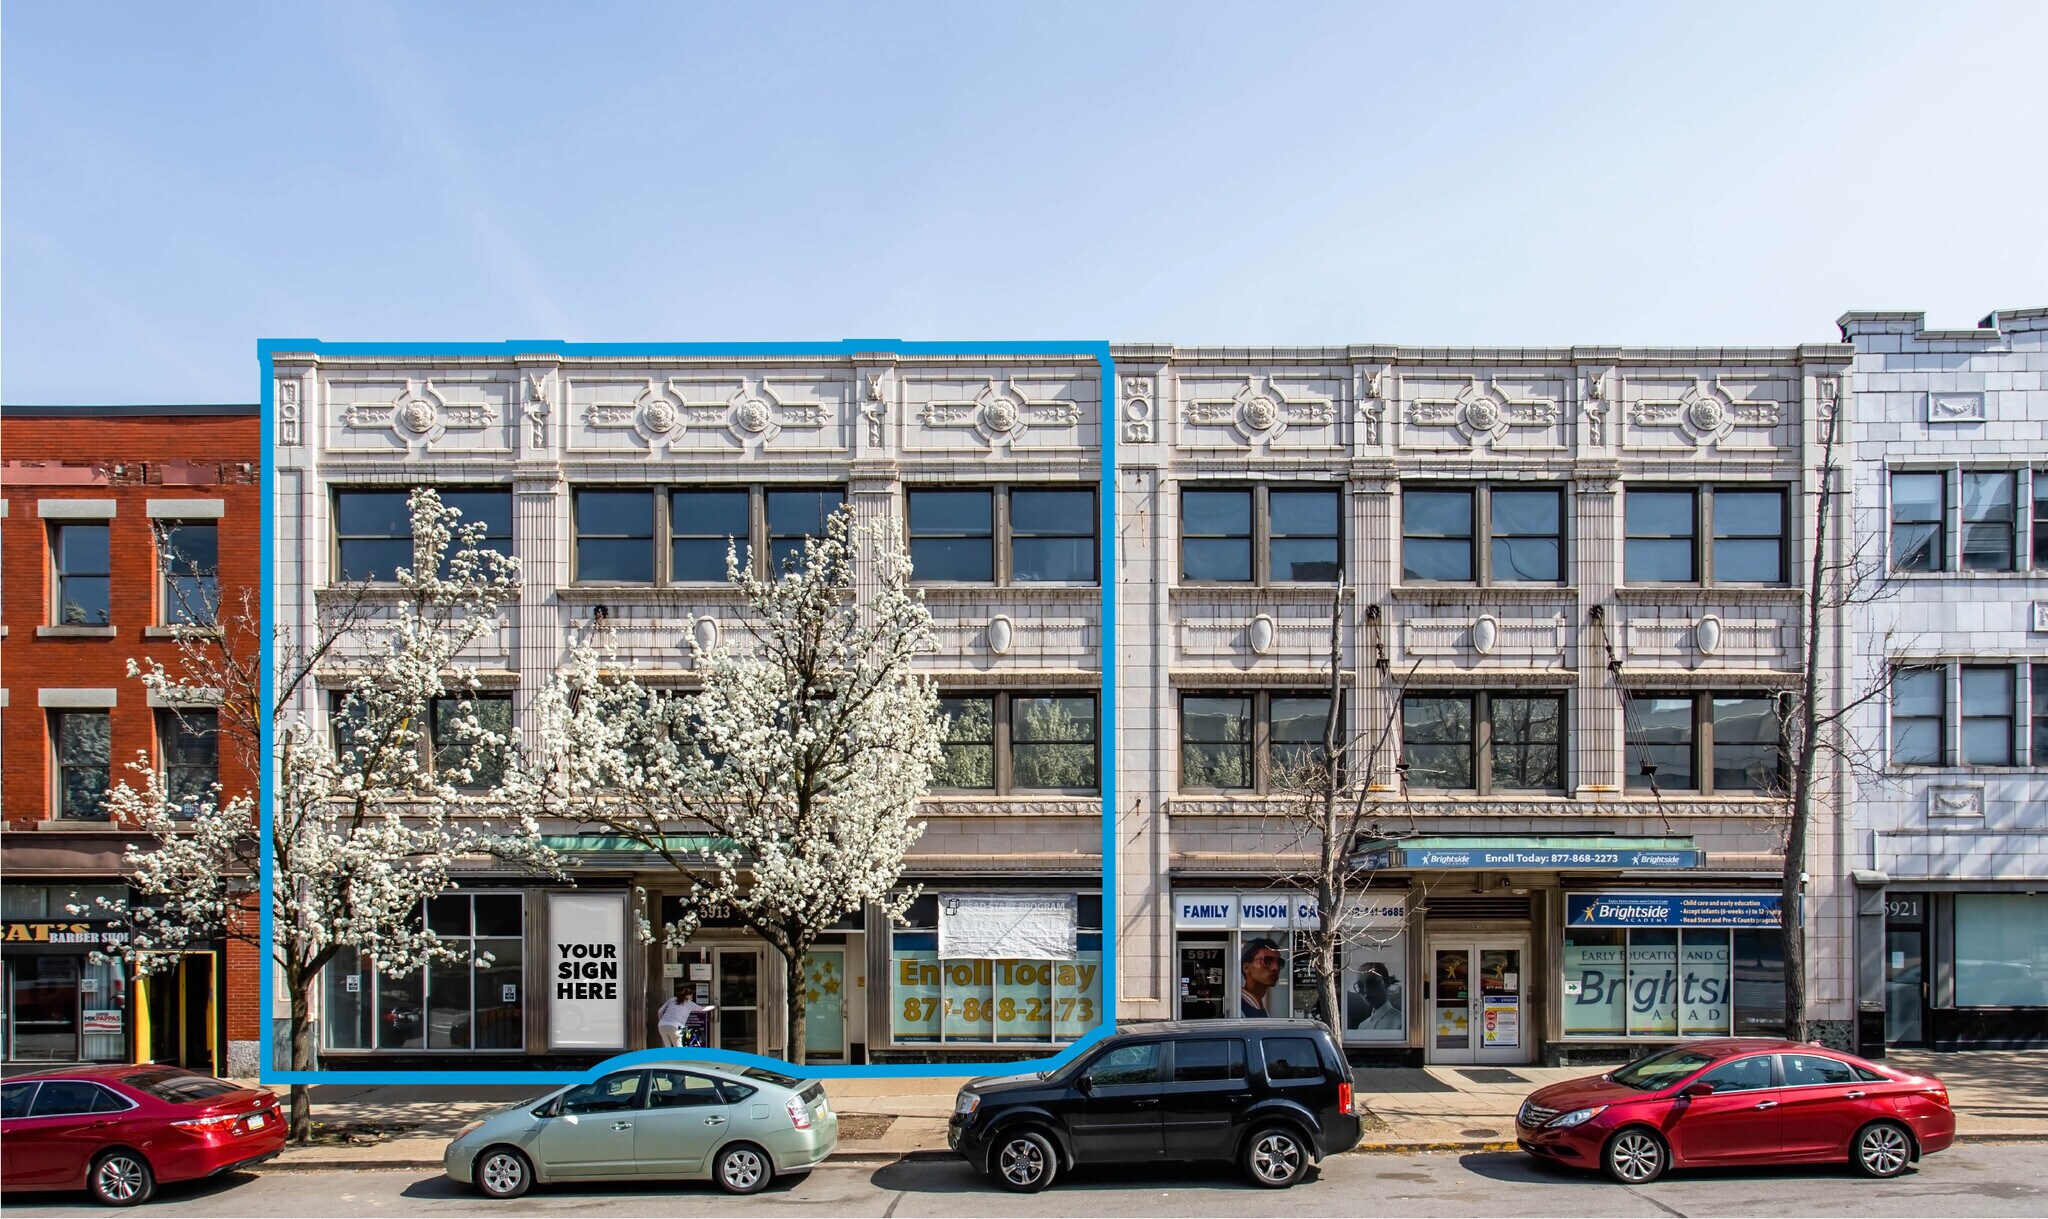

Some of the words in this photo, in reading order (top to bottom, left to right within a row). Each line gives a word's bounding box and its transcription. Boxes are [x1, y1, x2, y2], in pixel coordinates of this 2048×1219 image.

[1431, 854, 1470, 864] Brightside
[1485, 854, 1514, 863] Enroll
[1516, 854, 1549, 864] Today:
[1551, 854, 1618, 863] 877-868-2273
[1641, 855, 1680, 864] Brightside
[700, 905, 731, 918] 5913
[1019, 902, 1066, 911] PROGRAM
[1183, 905, 1229, 918] FAMILY
[1242, 905, 1287, 918] VISION
[1298, 905, 1321, 918] CA
[1599, 905, 1669, 920] Brightside
[1884, 901, 1919, 916] 5921
[49, 932, 100, 943] BARBER
[557, 943, 617, 959] YOUR
[1188, 950, 1218, 959] 5917
[1581, 950, 1616, 961] EARLY
[1620, 950, 1683, 961] EUCATIO
[1687, 951, 1713, 960] AND
[557, 961, 617, 979] SIGN
[557, 982, 617, 1000] HERE
